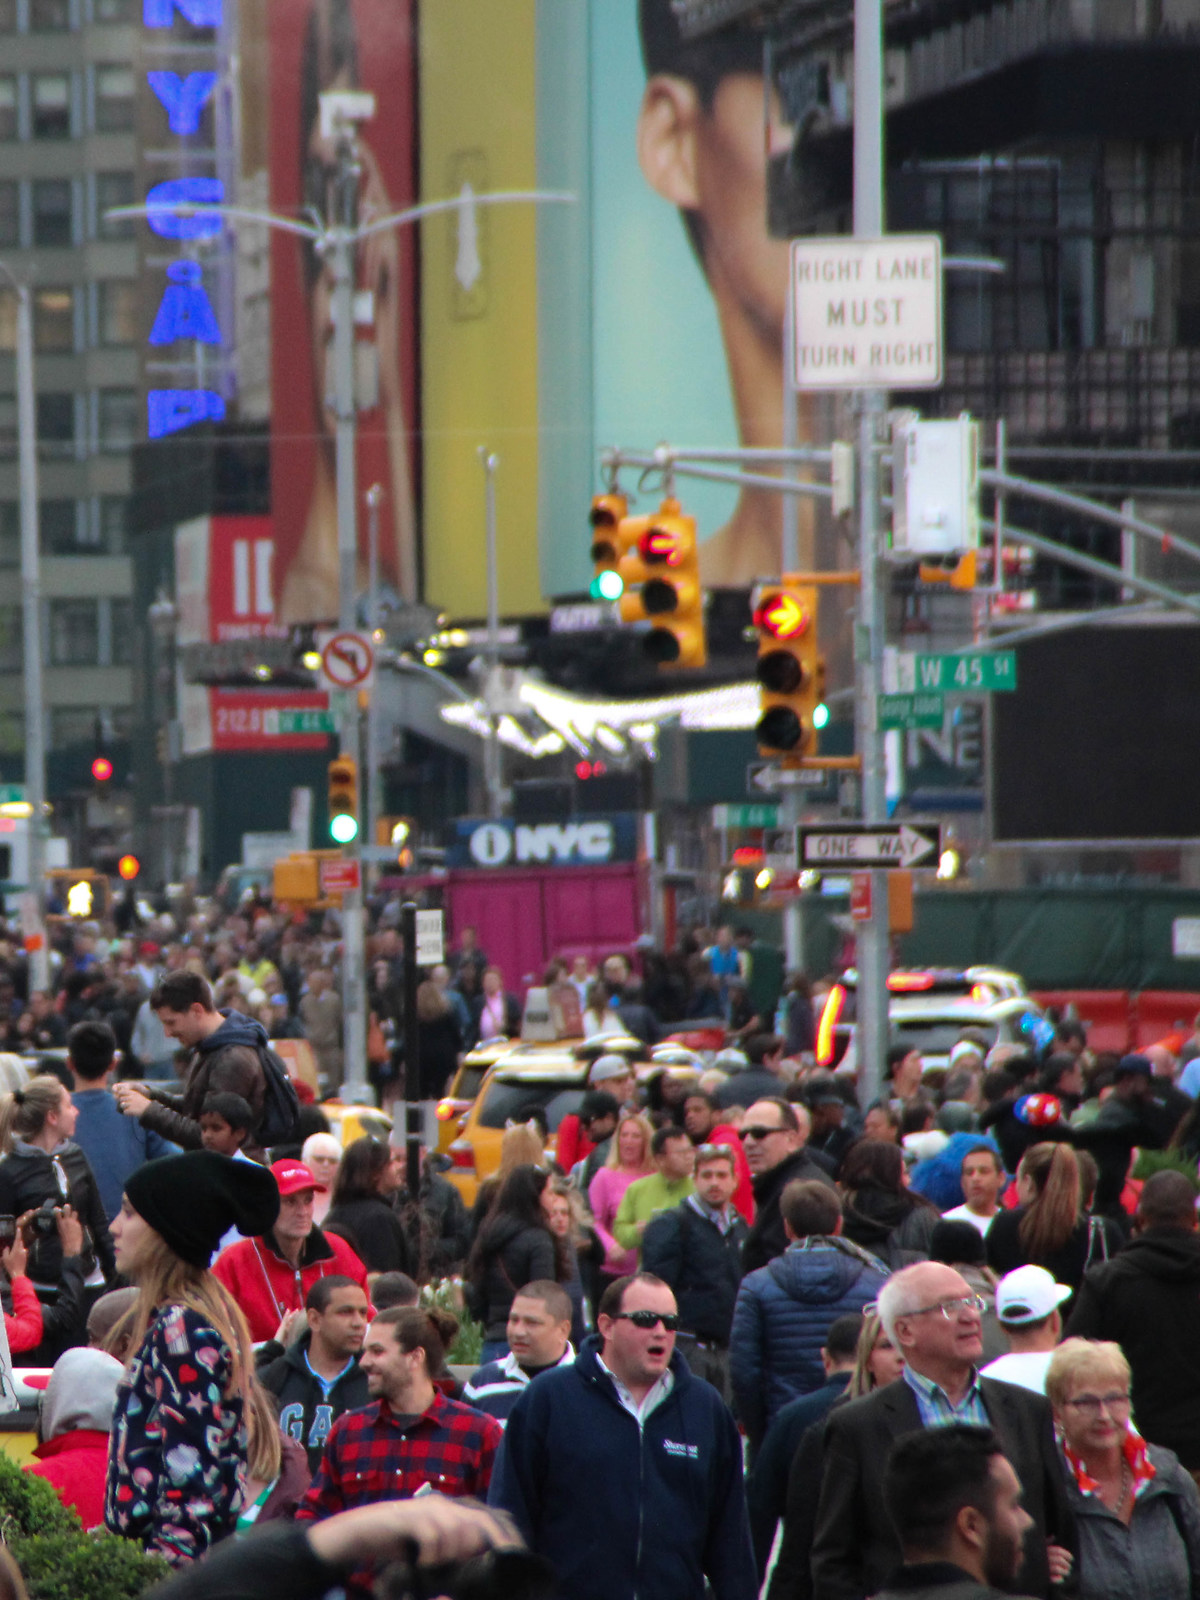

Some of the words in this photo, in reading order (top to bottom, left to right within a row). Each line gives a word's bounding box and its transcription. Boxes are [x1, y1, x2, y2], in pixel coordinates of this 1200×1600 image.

[799, 259, 862, 282] RIGHT
[876, 256, 932, 281] LANE
[827, 297, 904, 327] MUST
[801, 344, 856, 368] TURN
[870, 342, 934, 366] RIGHT
[920, 658, 942, 687] W
[954, 658, 982, 686] 45
[515, 821, 613, 864] NYC
[817, 837, 857, 856] ONE
[877, 836, 920, 856] WAY
